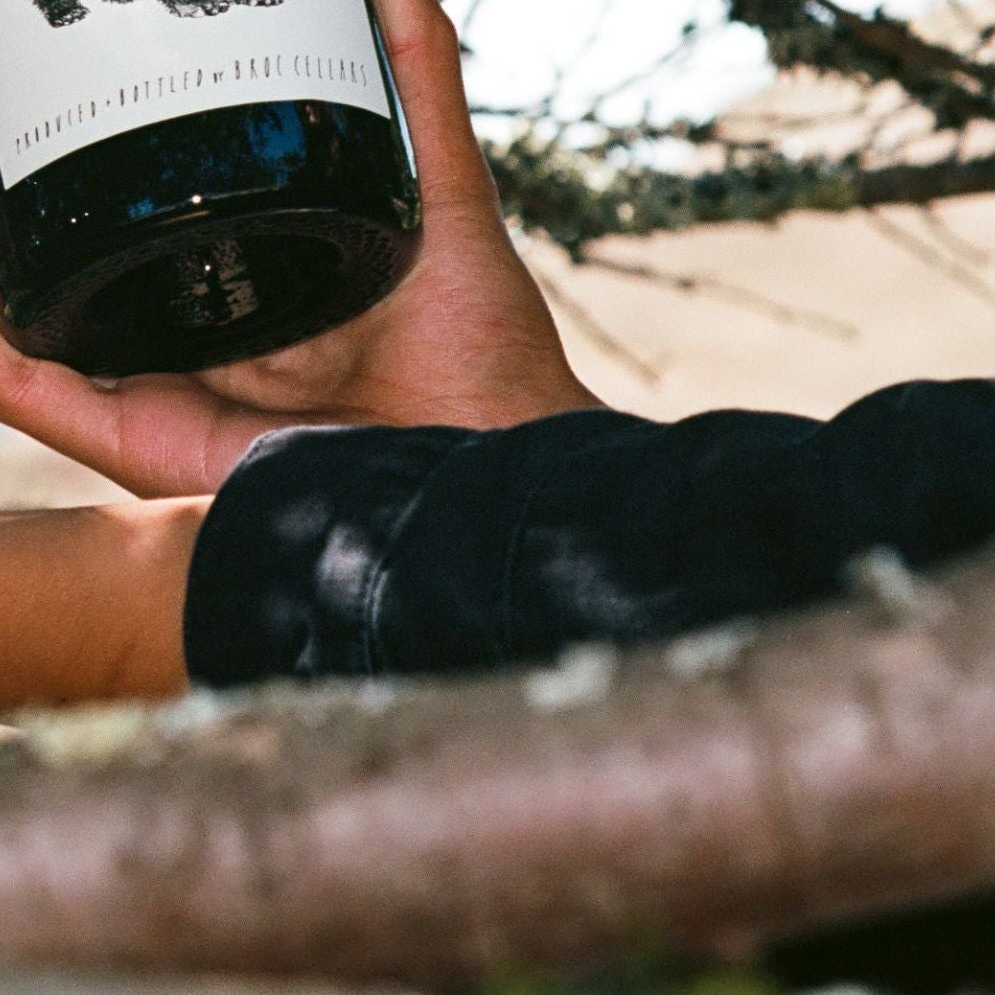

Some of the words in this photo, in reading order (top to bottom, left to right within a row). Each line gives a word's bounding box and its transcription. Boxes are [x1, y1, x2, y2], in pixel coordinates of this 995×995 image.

[16, 101, 96, 155] PRODUCED
[119, 68, 203, 107] BOTTLED
[213, 70, 224, 84] BY
[234, 54, 282, 81] BROC
[293, 54, 367, 88] CELLARS
